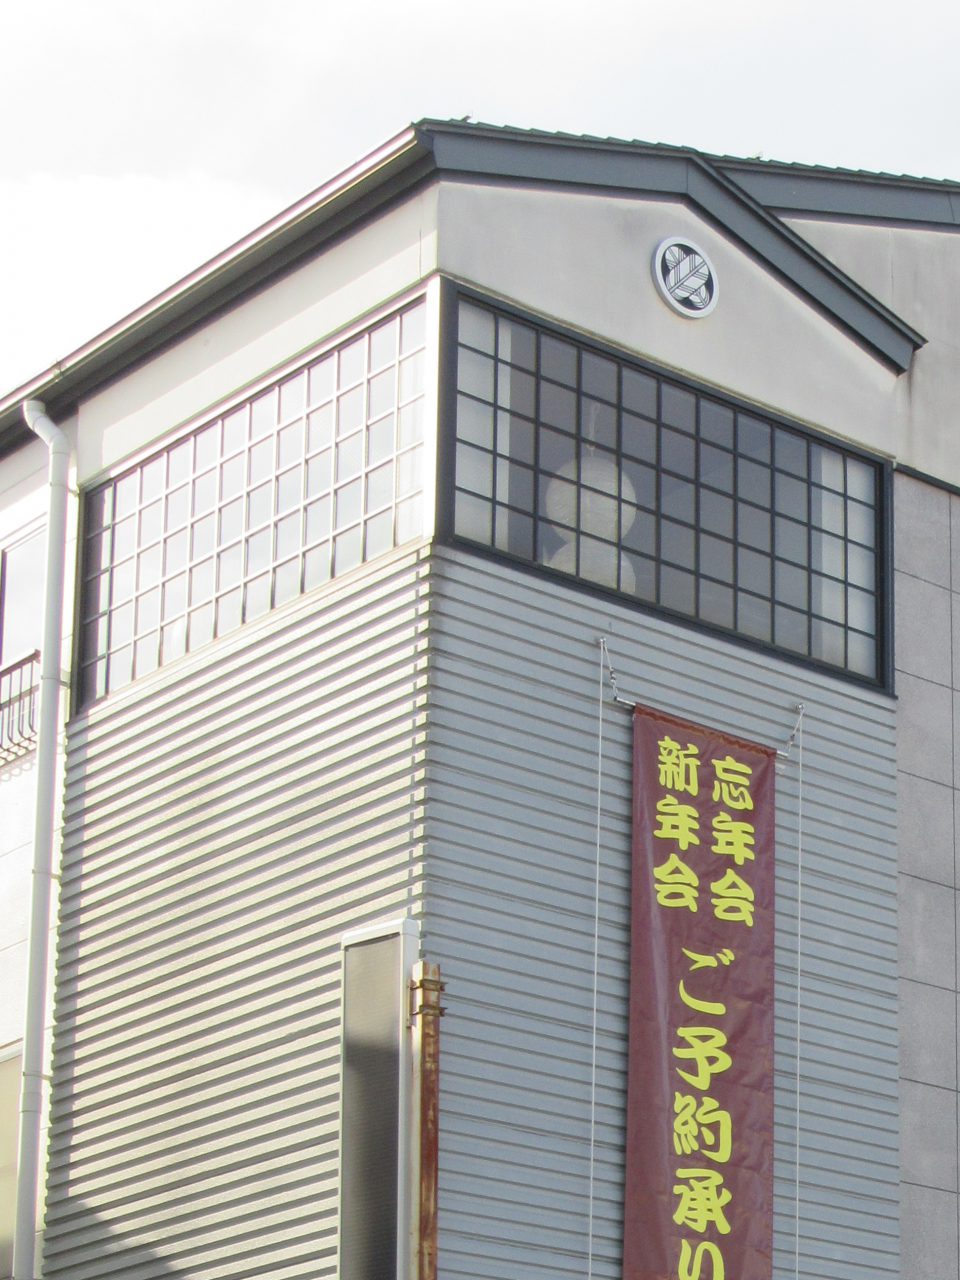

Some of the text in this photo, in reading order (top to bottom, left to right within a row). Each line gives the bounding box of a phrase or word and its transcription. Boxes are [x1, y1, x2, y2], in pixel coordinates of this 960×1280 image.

[652, 735, 700, 913] 新年会
[710, 755, 756, 928] 忘年会
